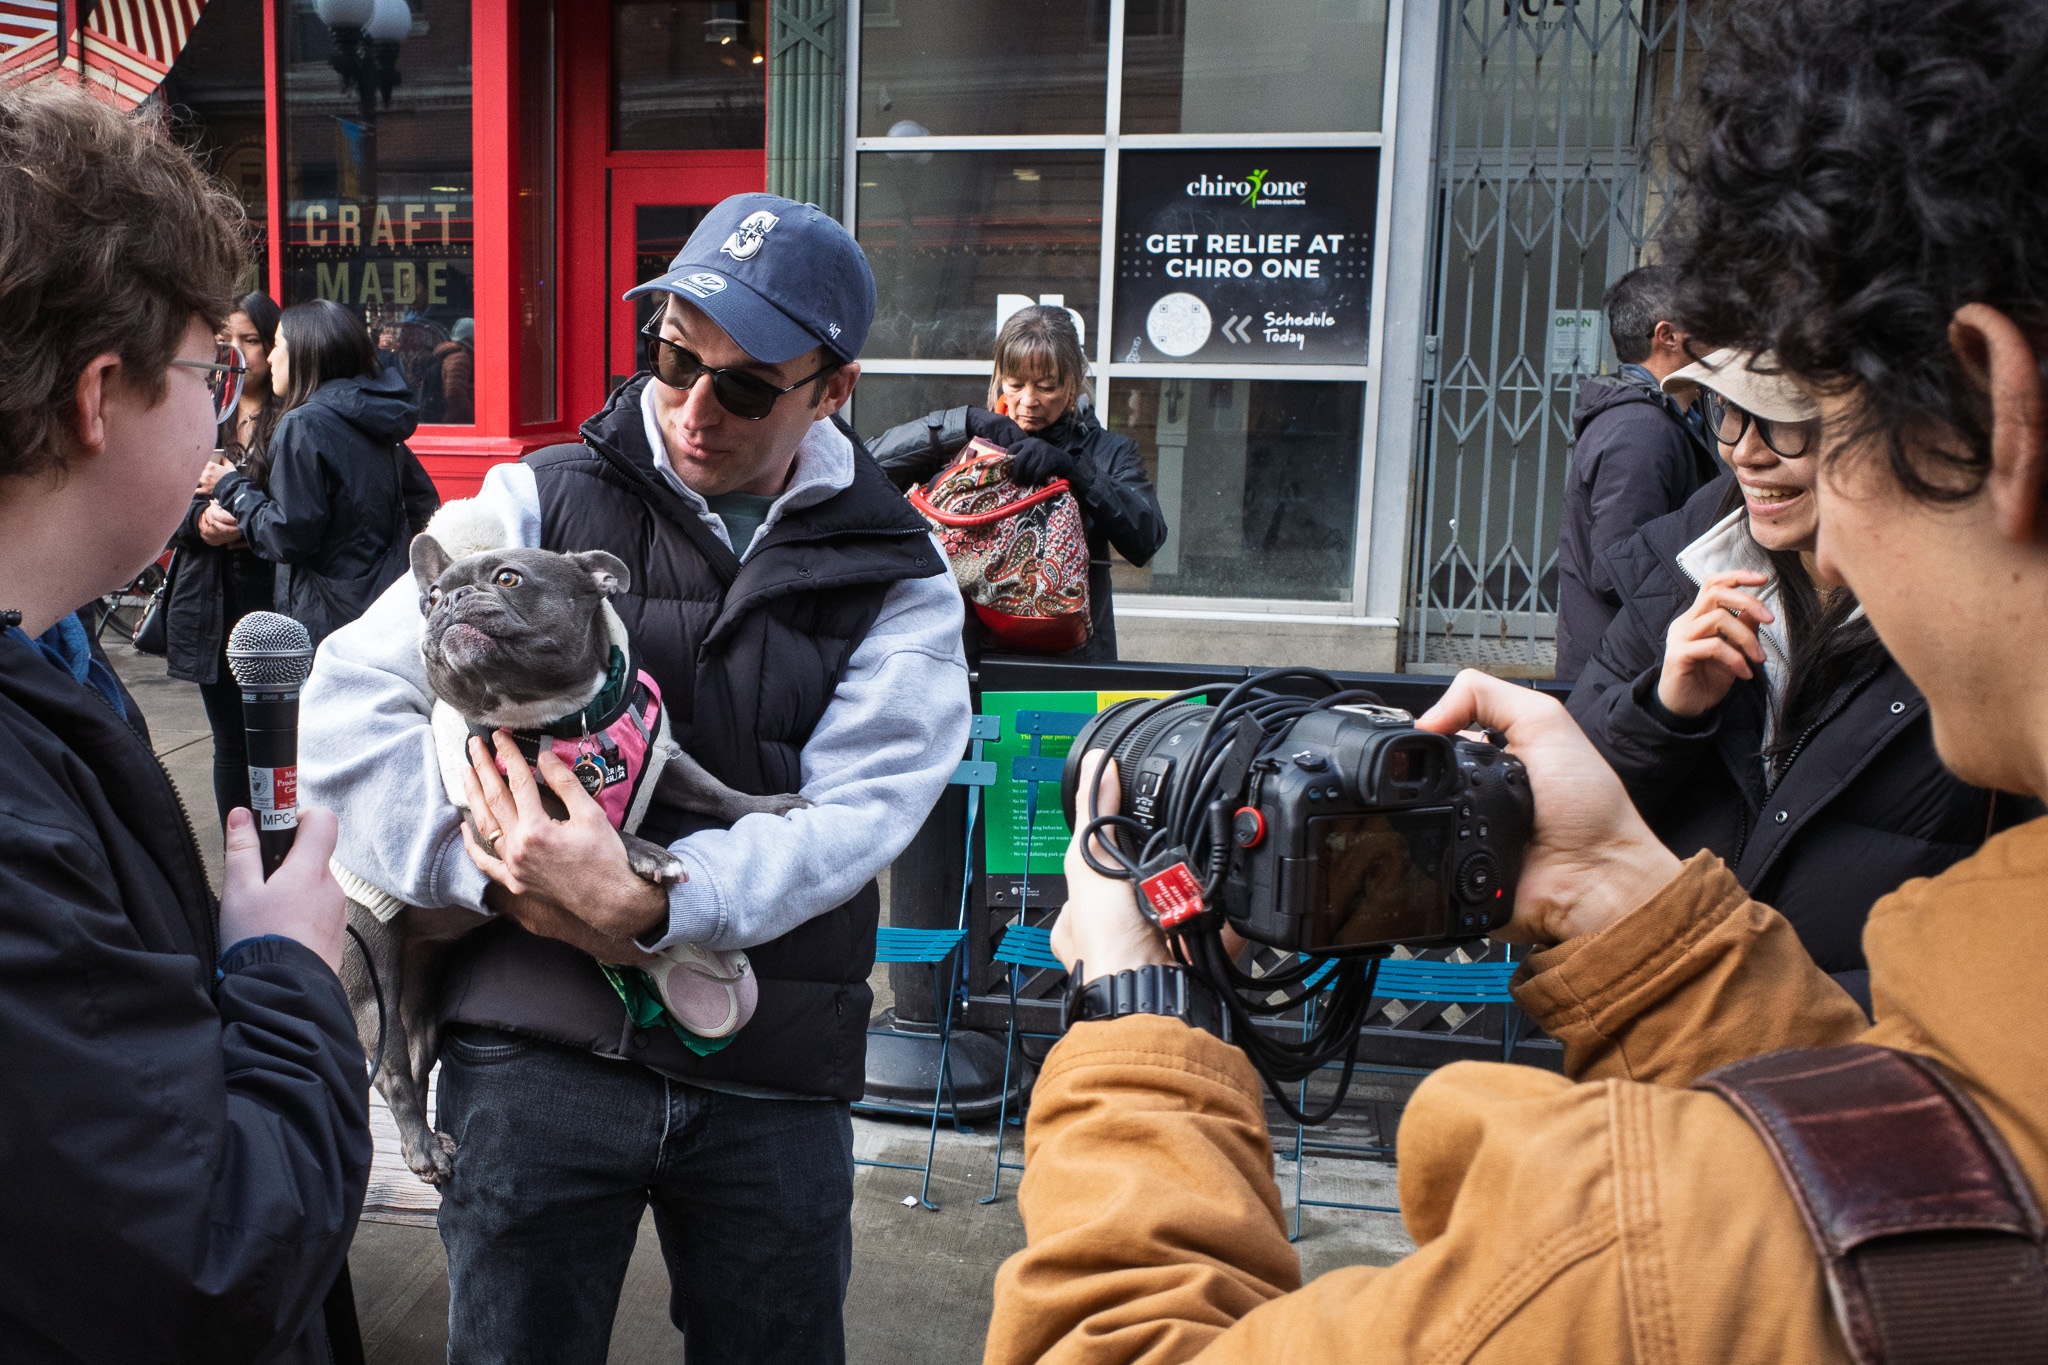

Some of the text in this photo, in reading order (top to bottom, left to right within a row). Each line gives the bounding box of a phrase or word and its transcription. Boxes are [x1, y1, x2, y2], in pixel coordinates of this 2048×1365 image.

[1186, 174, 1306, 196] chiro one
[305, 204, 456, 248] CRAFT
[1146, 234, 1345, 254] GET RELIEF AT
[1165, 259, 1321, 279] CHIRO ONE
[316, 262, 448, 304] MADE
[1263, 311, 1336, 328] Schedule
[1555, 316, 1592, 328] OPN
[1262, 329, 1305, 350] Today
[579, 775, 595, 783] SUKI
[263, 812, 295, 826] MPC-
